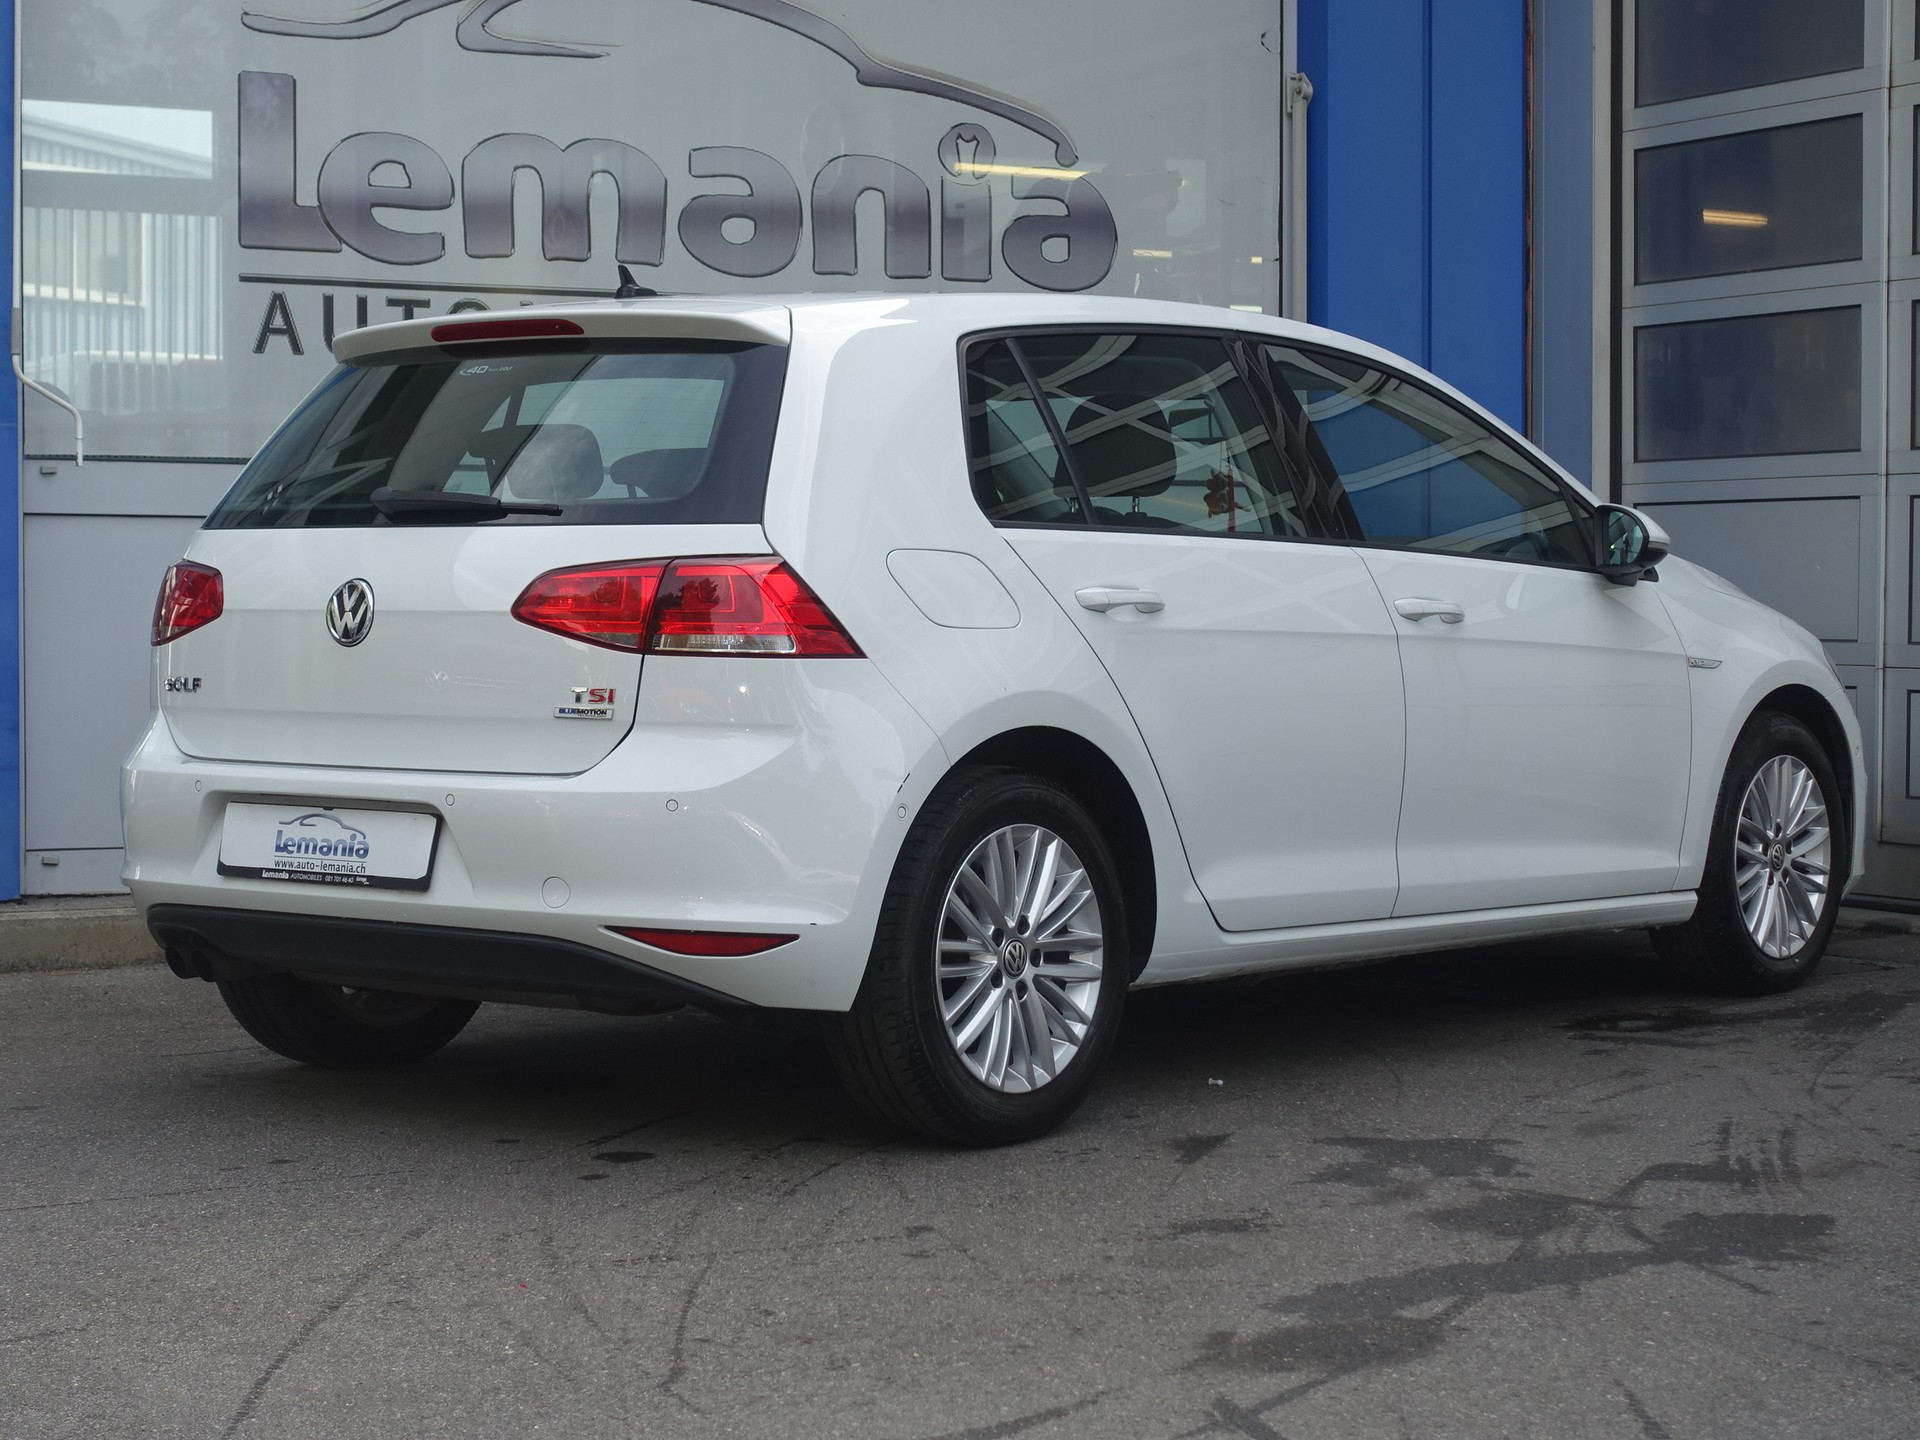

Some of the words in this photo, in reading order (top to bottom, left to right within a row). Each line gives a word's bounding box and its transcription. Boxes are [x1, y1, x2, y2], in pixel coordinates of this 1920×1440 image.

[239, 71, 1117, 291] Lemania
[570, 687, 616, 705] TSI
[275, 830, 370, 859] Lemania
[274, 859, 366, 874] www.auto-lemania.ch
